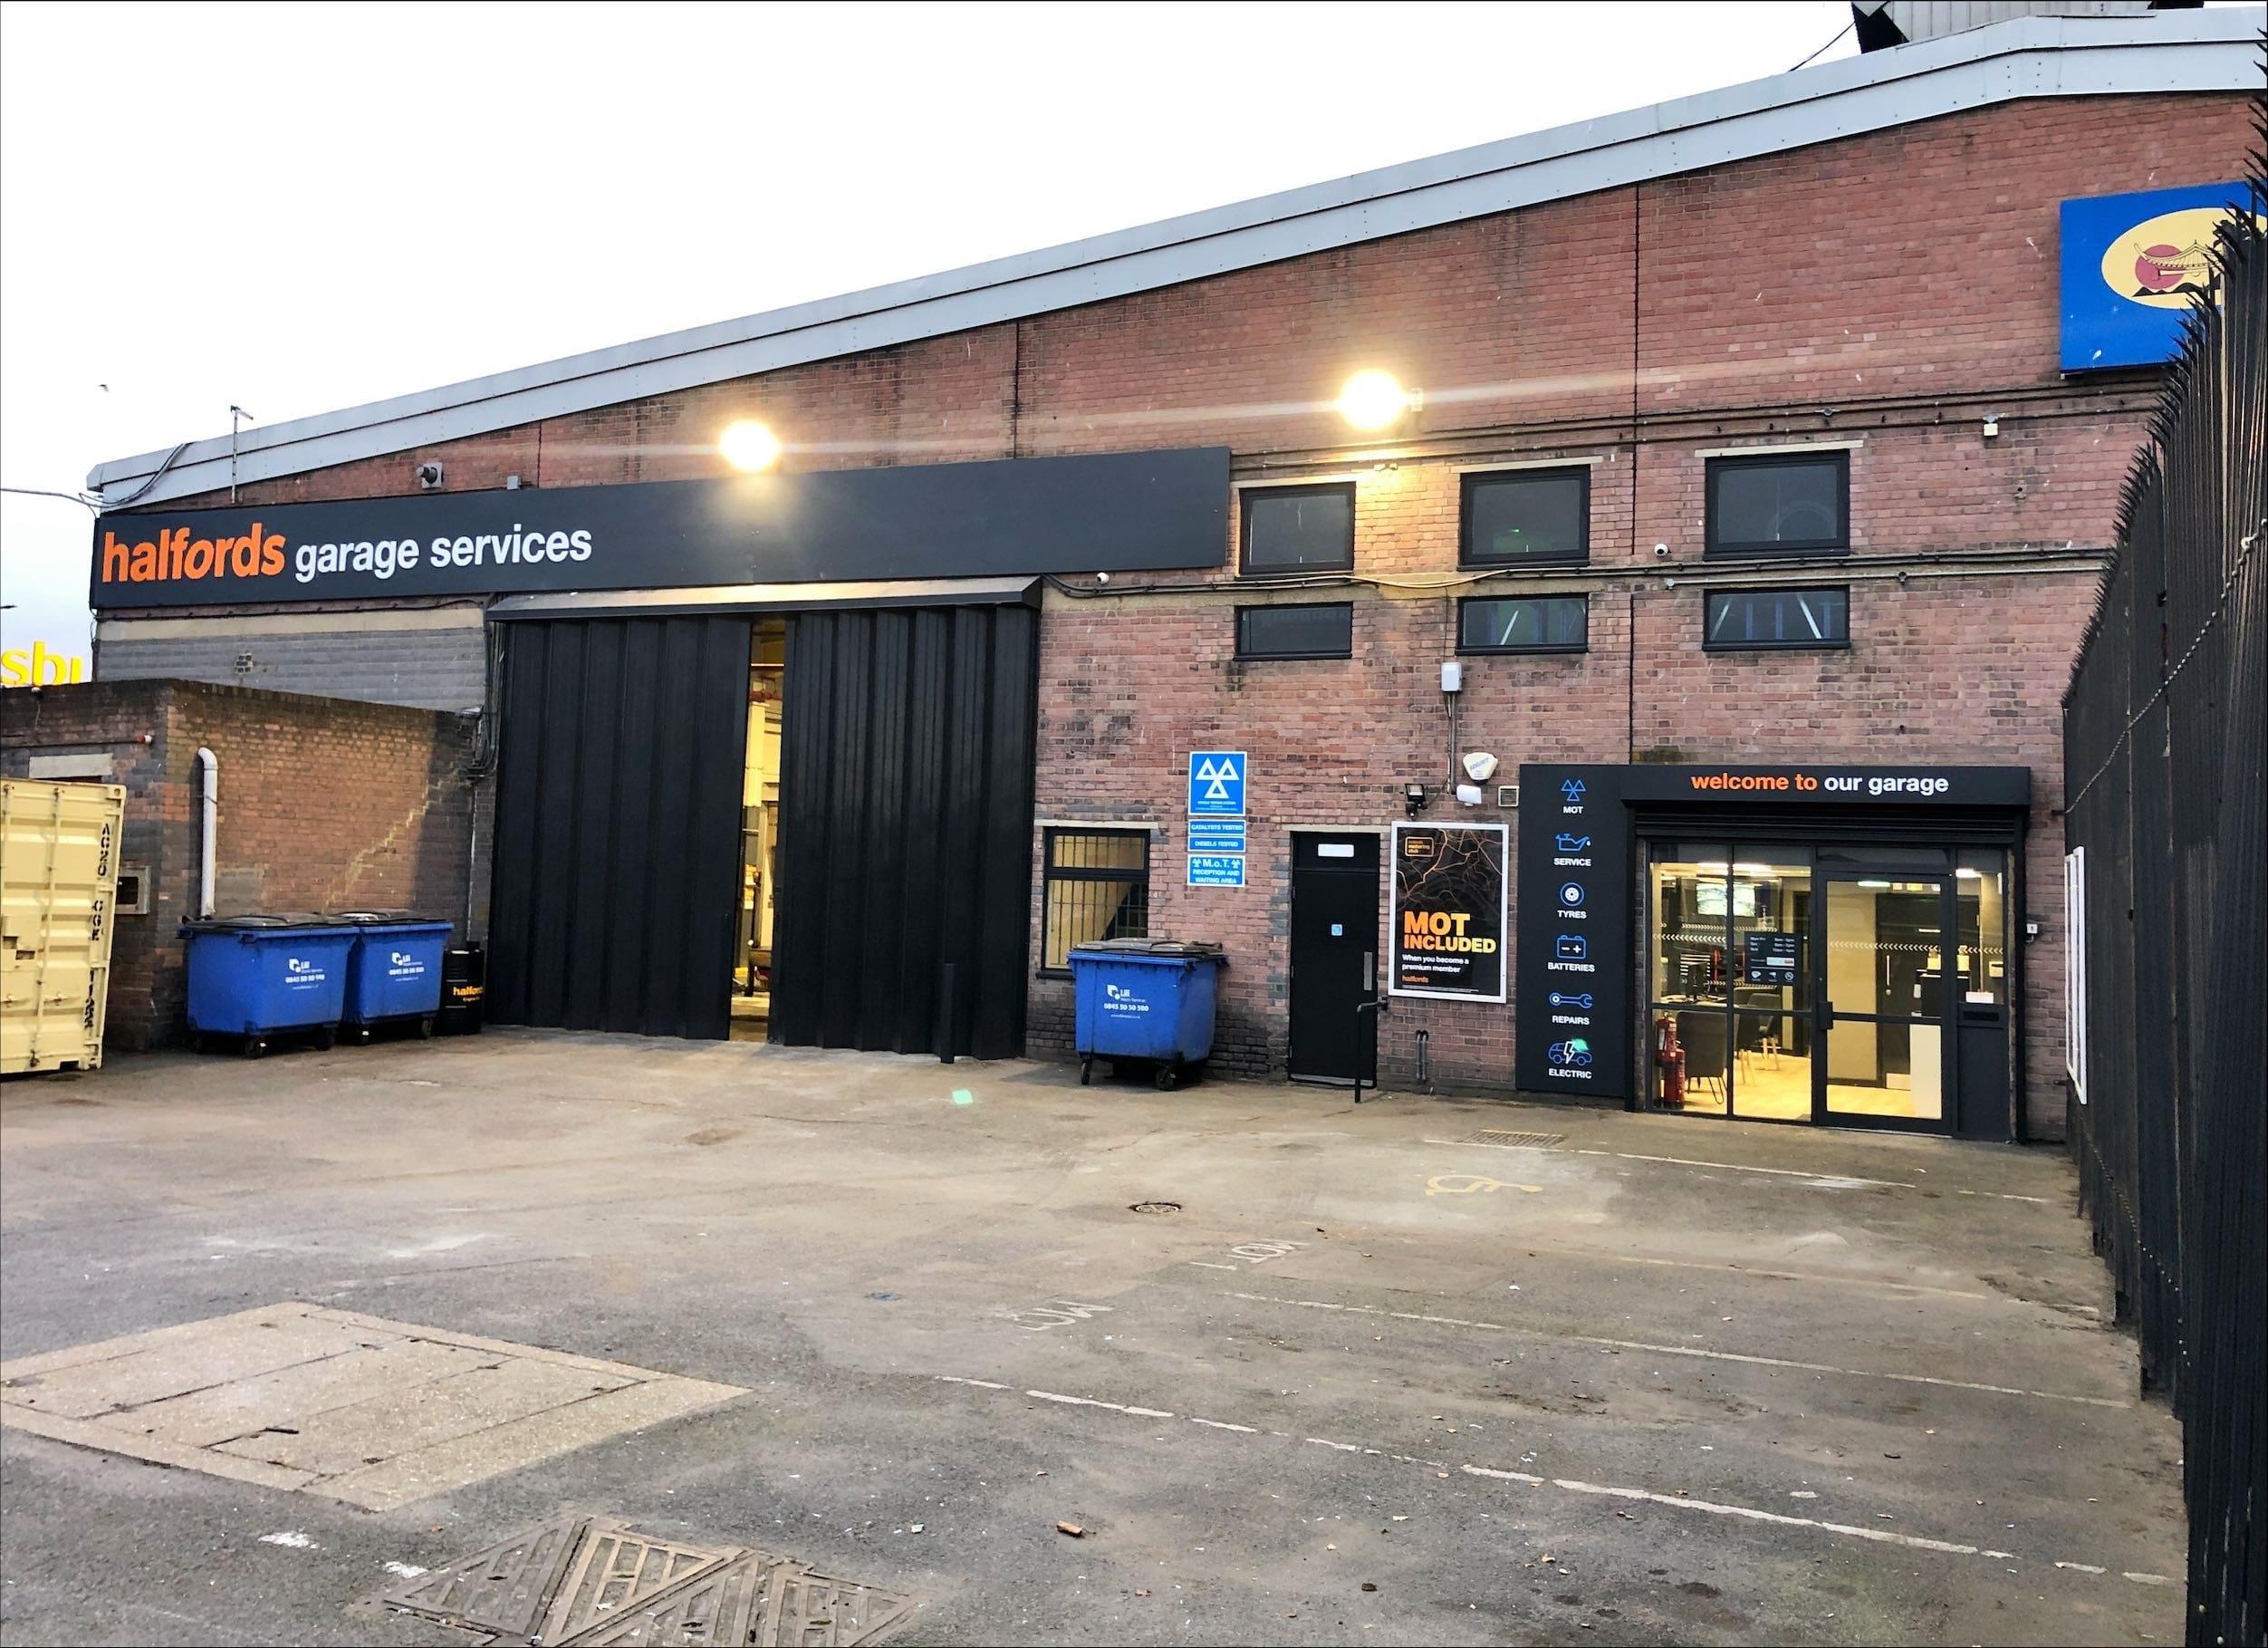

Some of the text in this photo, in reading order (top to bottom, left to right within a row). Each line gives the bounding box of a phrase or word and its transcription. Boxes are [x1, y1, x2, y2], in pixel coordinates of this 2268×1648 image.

[102, 523, 591, 583] halfords garage services
[1690, 773, 1949, 796] welcome to our garage
[1563, 805, 1583, 814] MOT
[1553, 858, 1591, 866] SERVICE
[1558, 910, 1587, 919] TYRES
[1405, 911, 1470, 936] MOT
[1404, 934, 1496, 953] INCLUDED
[1437, 956, 1464, 964] become
[1433, 965, 1461, 973] member
[1547, 962, 1595, 972] BATTERIES
[1402, 975, 1429, 983] halfords
[1552, 1016, 1590, 1025] REPAIRS
[1548, 1068, 1591, 1079] ELECTRIC
